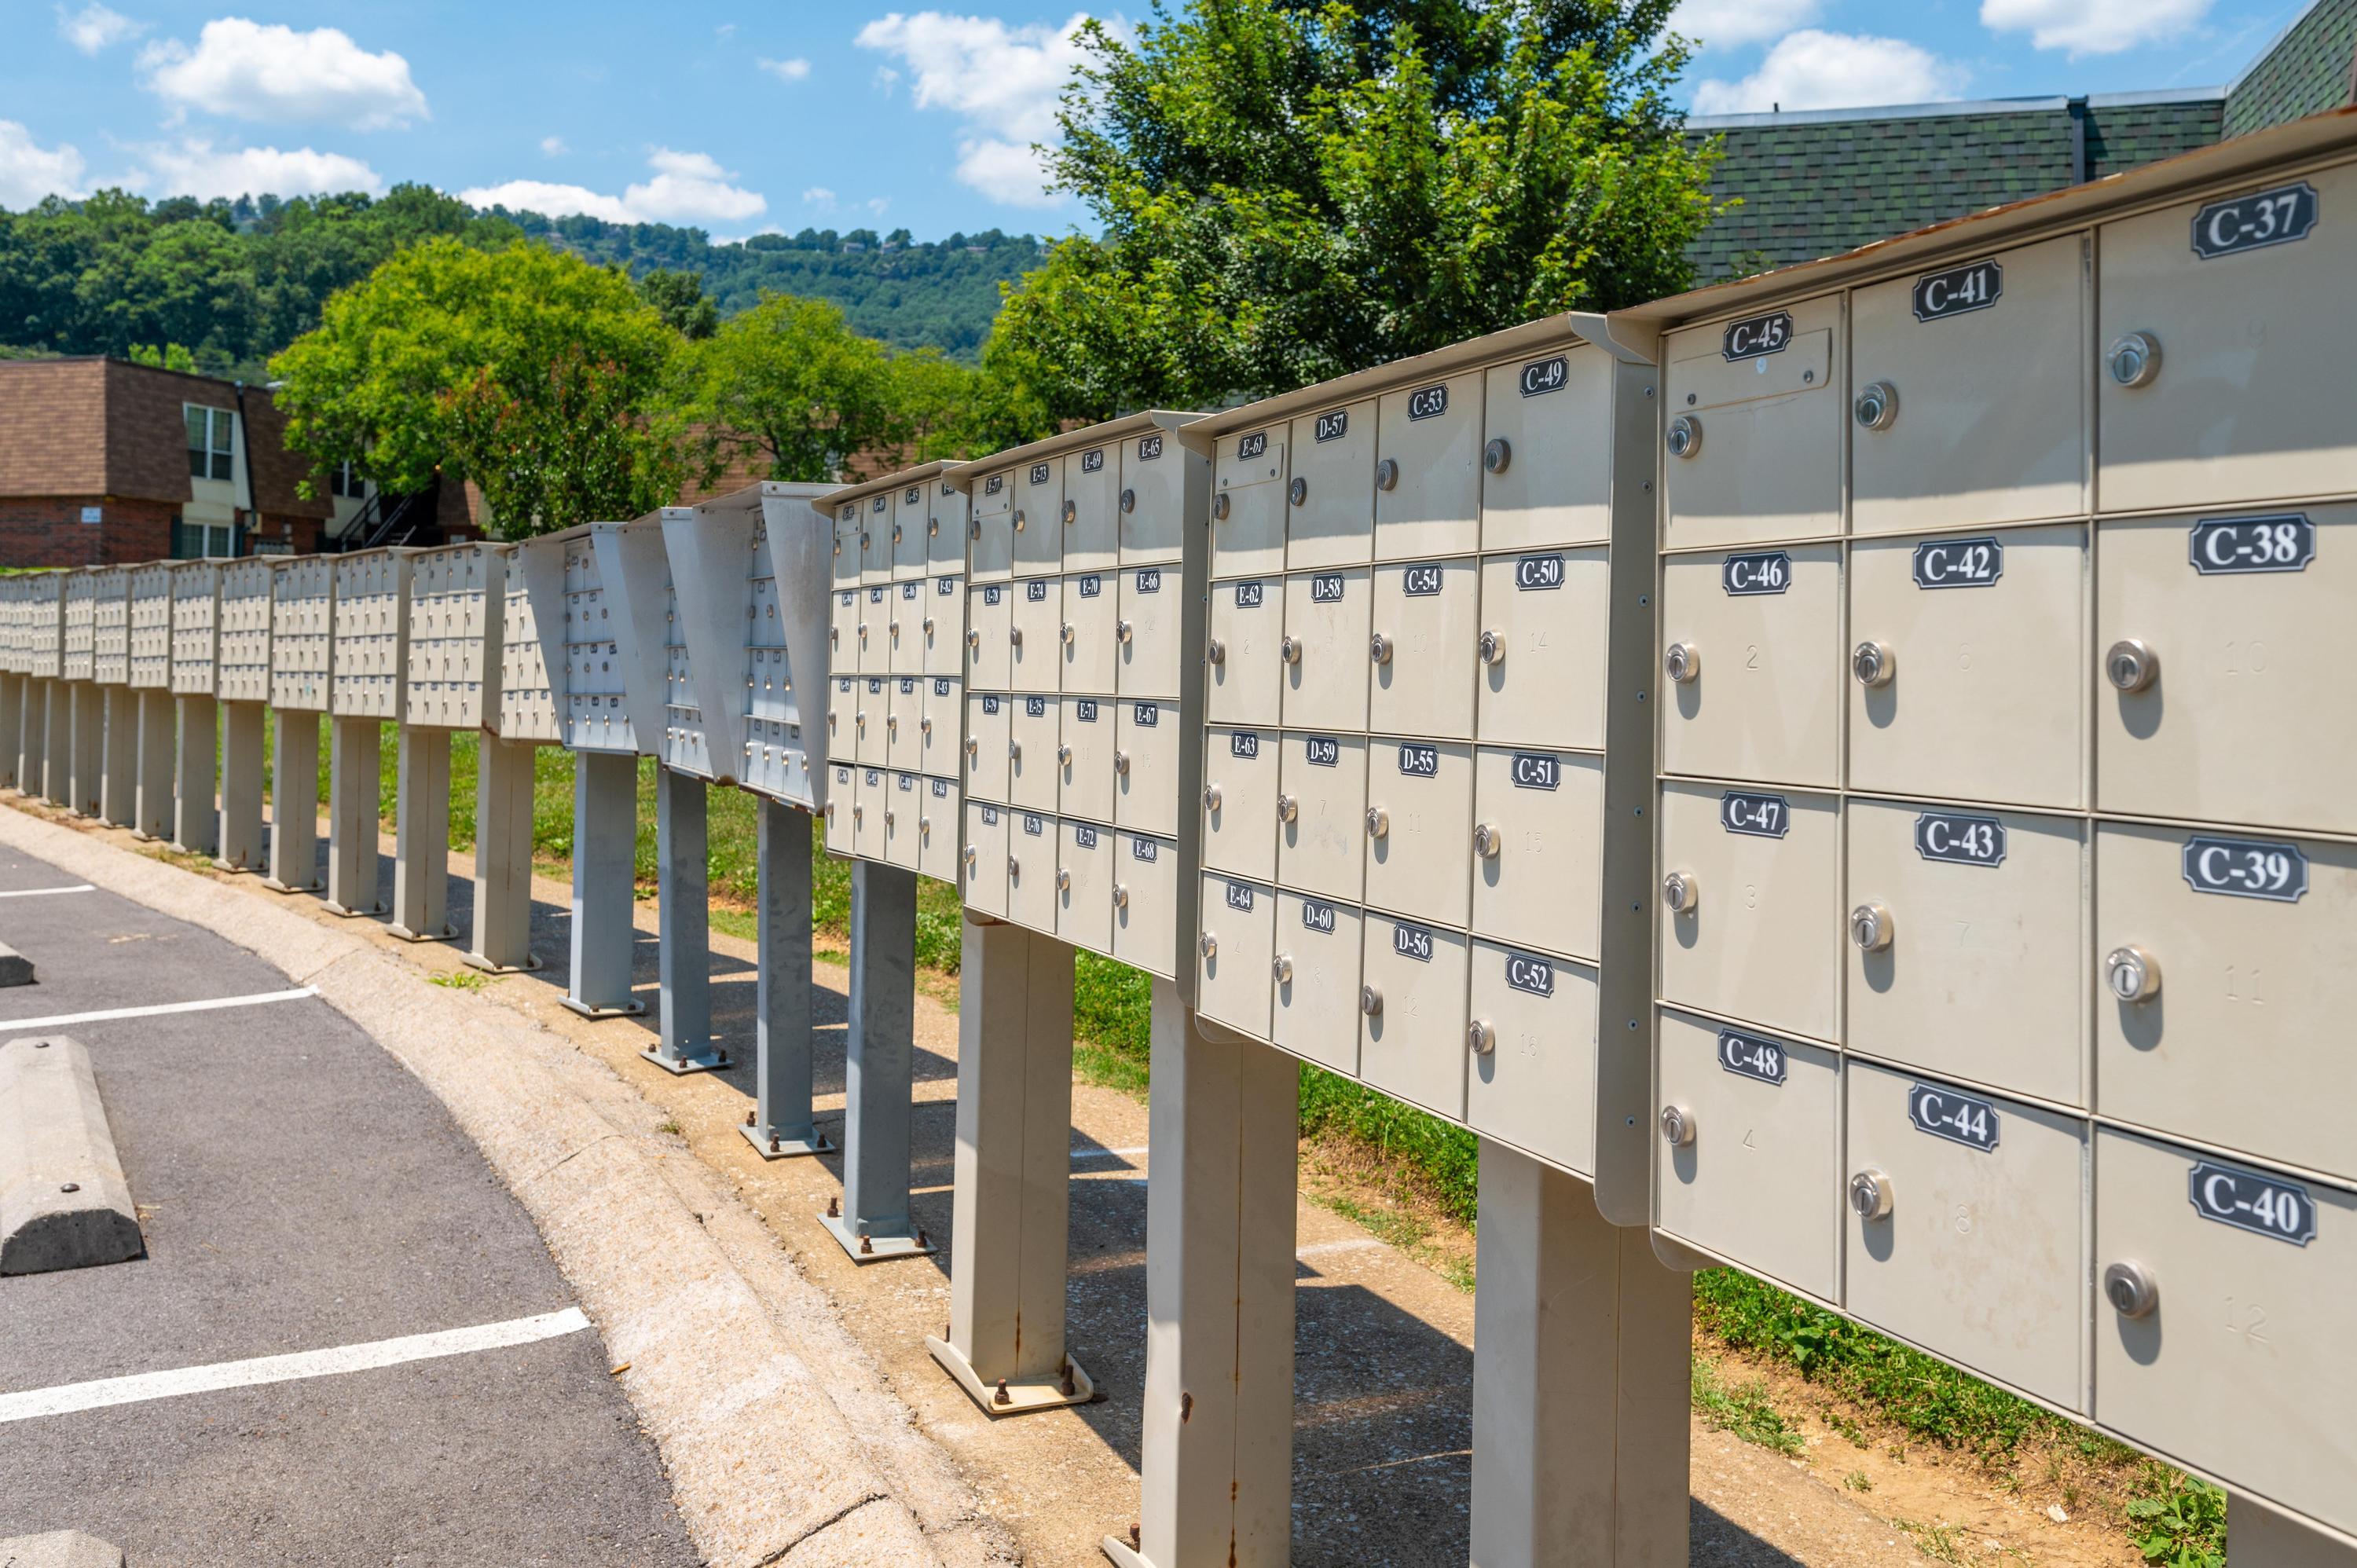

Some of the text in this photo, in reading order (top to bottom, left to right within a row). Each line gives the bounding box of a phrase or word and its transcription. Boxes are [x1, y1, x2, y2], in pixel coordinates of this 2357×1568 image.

[2209, 193, 2297, 246] C-37
[1926, 269, 1988, 311] C-41
[1732, 319, 1783, 353] C-45
[1527, 361, 1562, 390] C-49
[1414, 390, 1442, 415] C-53
[1320, 414, 1343, 438] D-57
[1142, 439, 1160, 456] E-65
[1242, 436, 1262, 456] E-61
[1085, 452, 1101, 468] E-69
[988, 478, 1001, 491] E-77
[1033, 467, 1047, 482] E-73
[2206, 526, 2297, 564] C-38
[1523, 560, 1558, 584] C-50
[1732, 559, 1782, 588] C-46
[1925, 546, 1989, 580] C-42
[1030, 584, 1043, 598] E-74
[1083, 578, 1098, 594] E-70
[1139, 573, 1158, 589] E-66
[1316, 578, 1340, 597] D-58
[1409, 569, 1437, 591] C-54
[1239, 585, 1259, 603] E-62
[1746, 645, 1759, 671] 2
[1028, 698, 1042, 714] E-75
[1080, 702, 1094, 718] E-71
[1137, 706, 1155, 723] E-67
[1235, 736, 1255, 754] E-63
[1310, 742, 1334, 761] D-59
[1404, 749, 1433, 771] D-55
[1519, 759, 1552, 783] C-51
[1026, 816, 1039, 833] E-76
[1730, 799, 1779, 830] C-47
[1079, 829, 1094, 844] E-72
[1926, 821, 1993, 857] C-43
[1136, 840, 1154, 859] E-68
[2199, 847, 2289, 889] C-39
[1230, 886, 1250, 907] E-64
[1307, 905, 1331, 929] D-60
[1398, 929, 1428, 955] D-56
[1512, 960, 1546, 990] C-52
[1727, 1039, 1777, 1076] C-48
[1920, 1094, 1987, 1141] C-44
[2205, 1175, 2299, 1233] C-40
